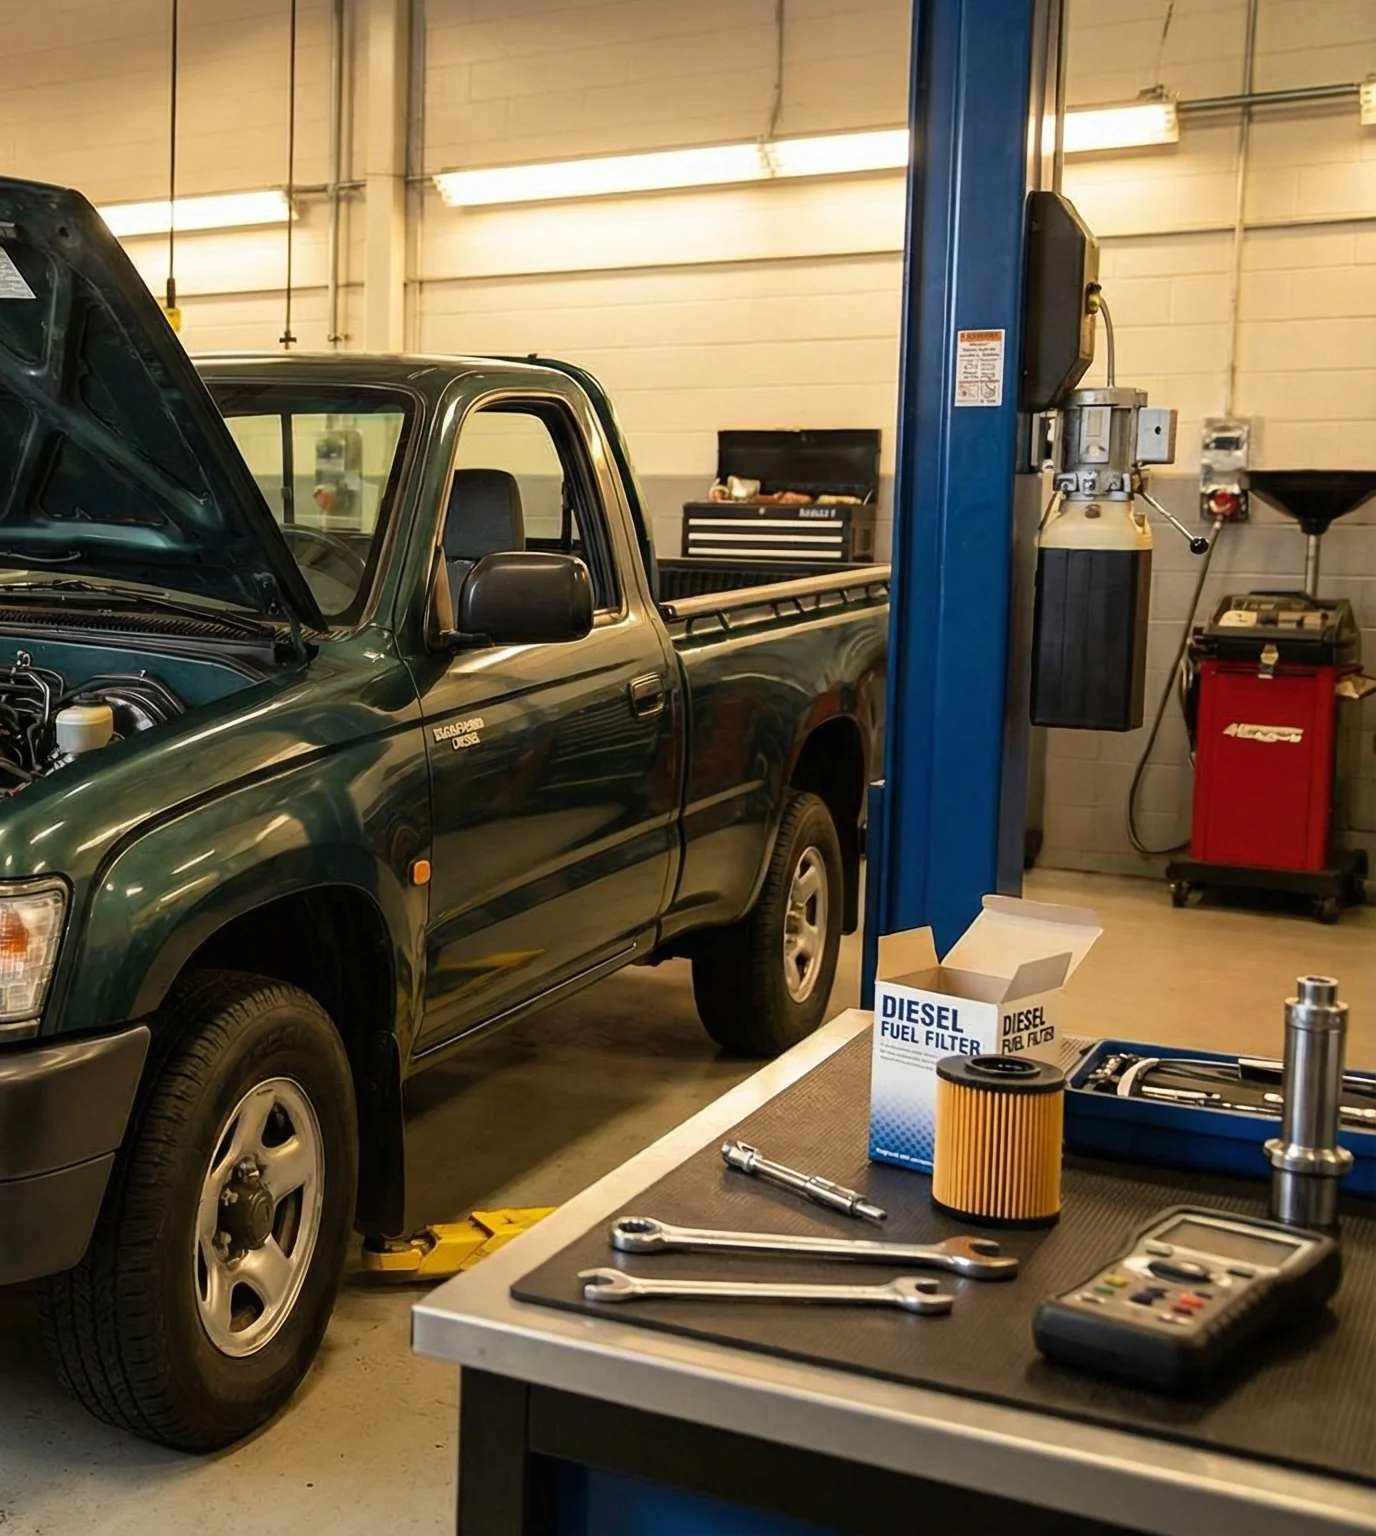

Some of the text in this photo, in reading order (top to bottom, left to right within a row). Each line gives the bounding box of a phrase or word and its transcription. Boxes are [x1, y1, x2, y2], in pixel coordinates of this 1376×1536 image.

[882, 994, 964, 1033] DIESEL
[1003, 1006, 1045, 1037] DIESEL
[880, 1020, 919, 1044] FUEL
[925, 1030, 981, 1055] FILTER
